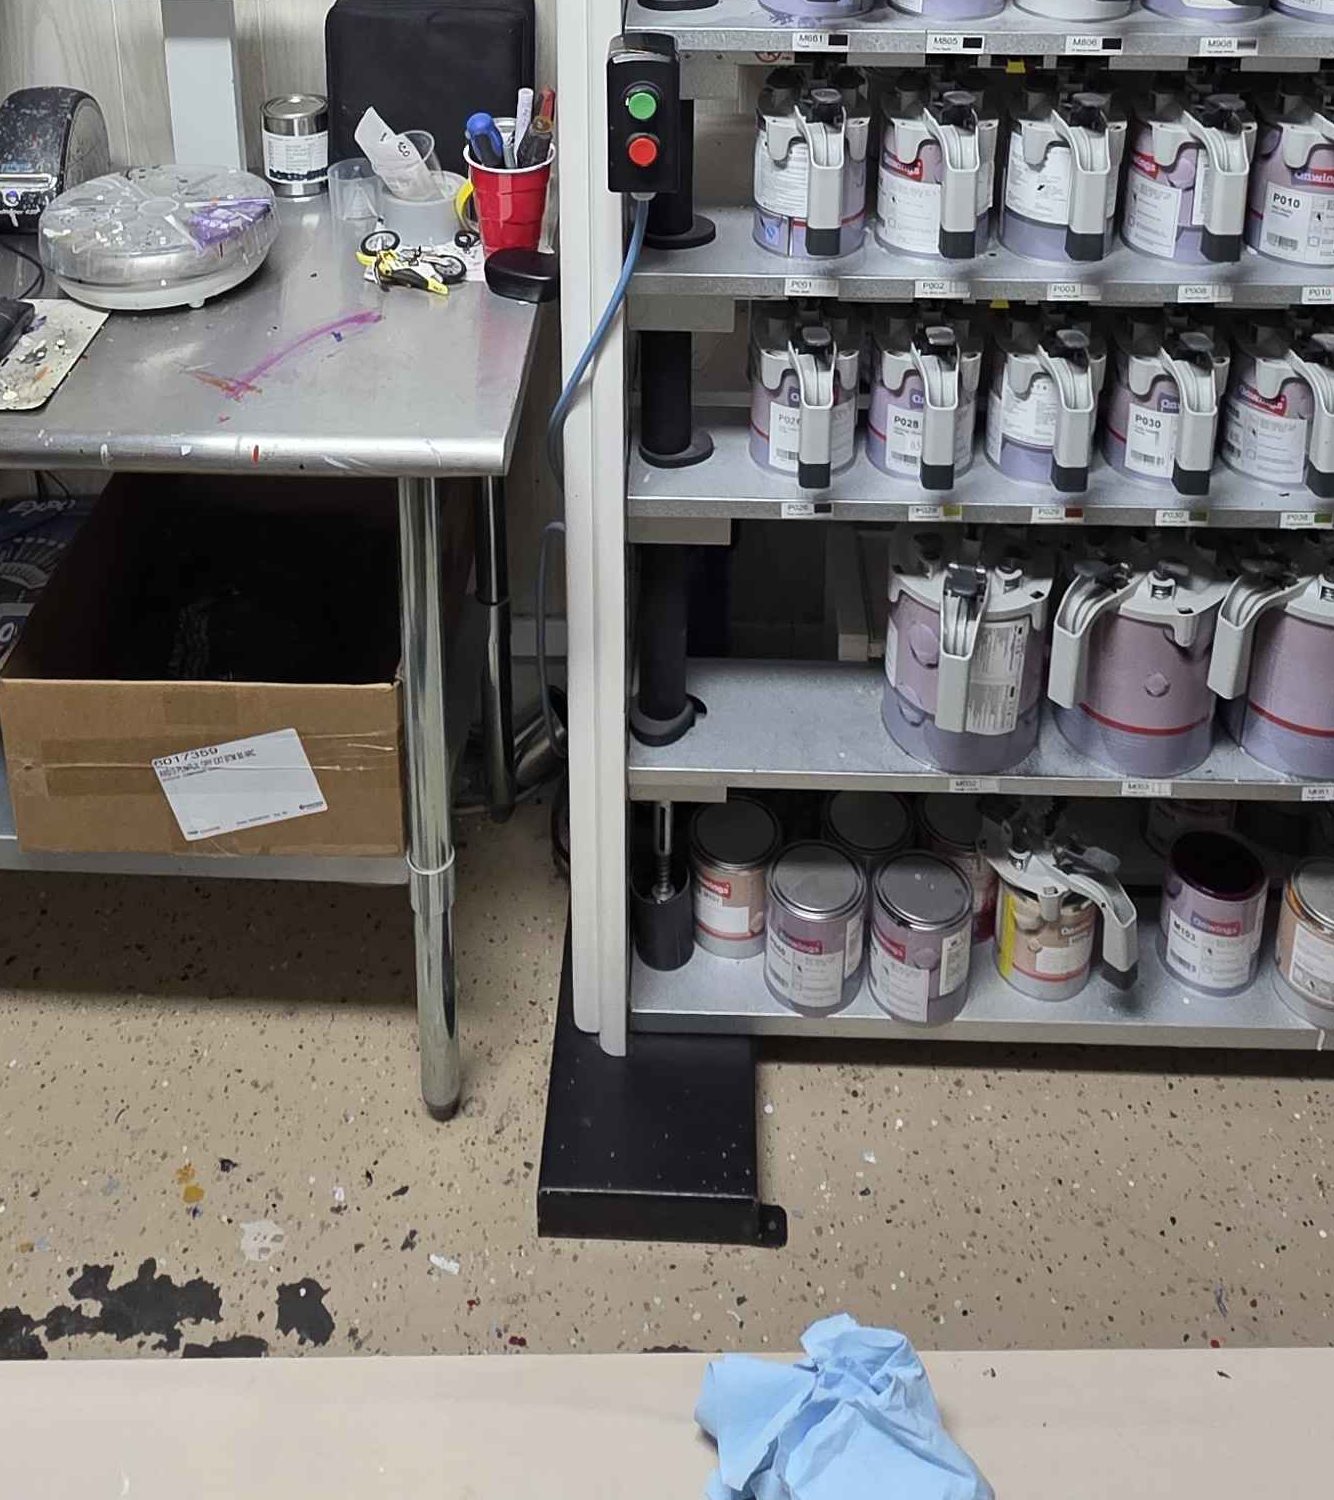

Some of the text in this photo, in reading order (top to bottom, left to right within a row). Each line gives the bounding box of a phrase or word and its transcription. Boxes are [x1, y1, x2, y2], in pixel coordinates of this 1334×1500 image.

[1272, 192, 1301, 209] P010
[1134, 414, 1163, 429] P030
[8, 499, 76, 517] EXPO
